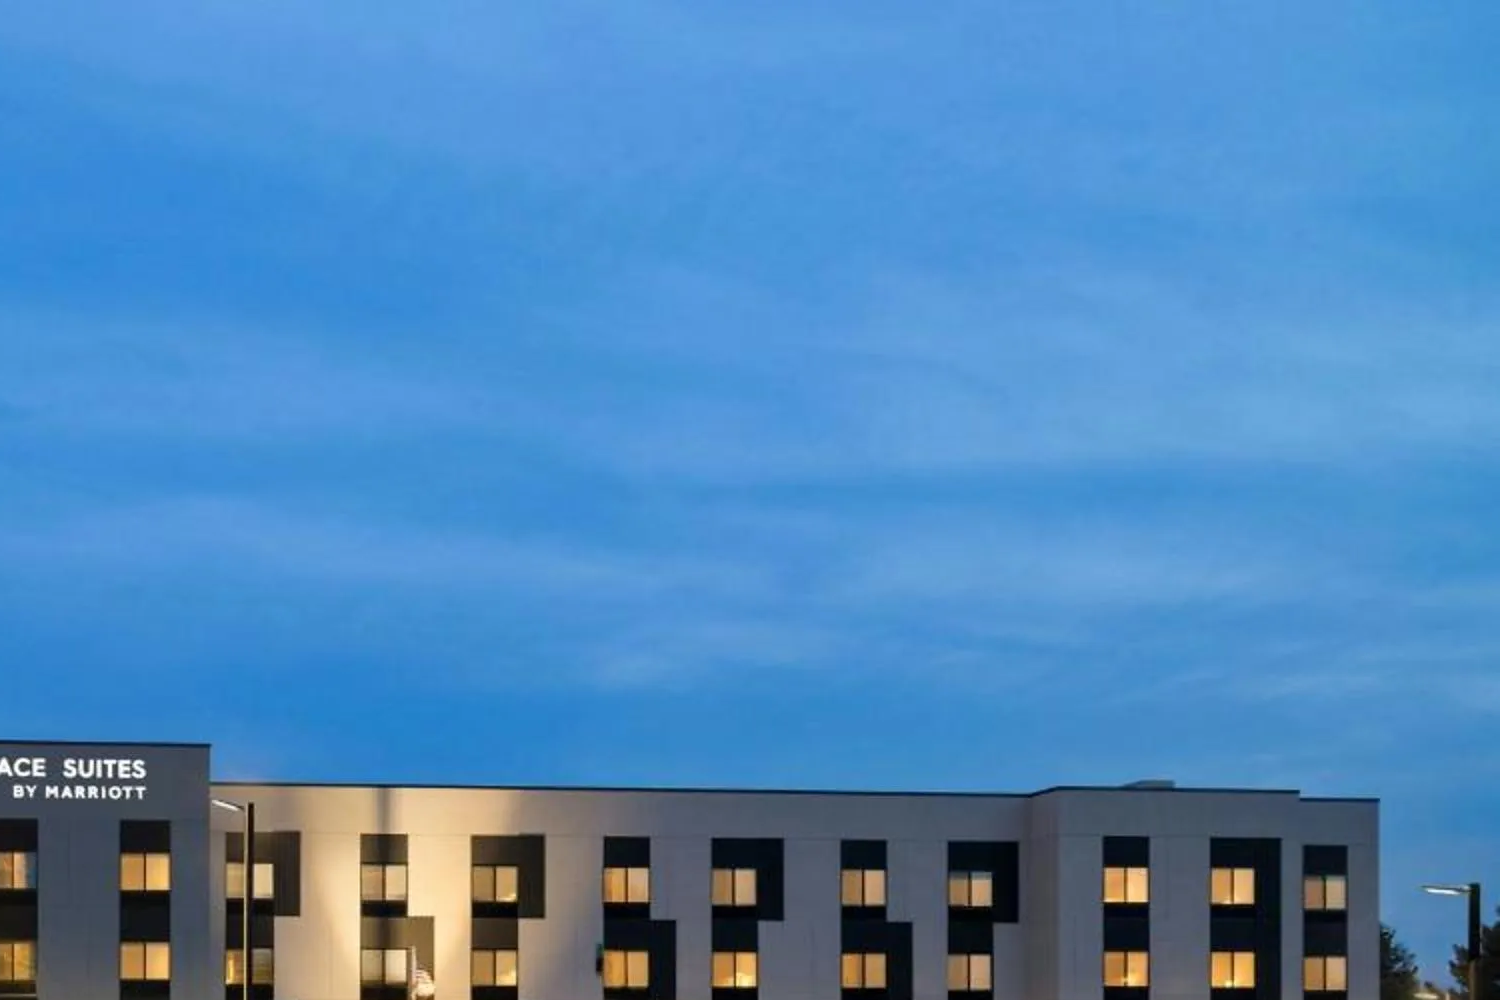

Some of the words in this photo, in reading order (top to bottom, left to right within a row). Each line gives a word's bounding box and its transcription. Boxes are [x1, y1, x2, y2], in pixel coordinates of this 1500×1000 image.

[62, 758, 147, 779] SUITES
[12, 785, 37, 799] BY
[45, 785, 147, 800] MARRIOTT
